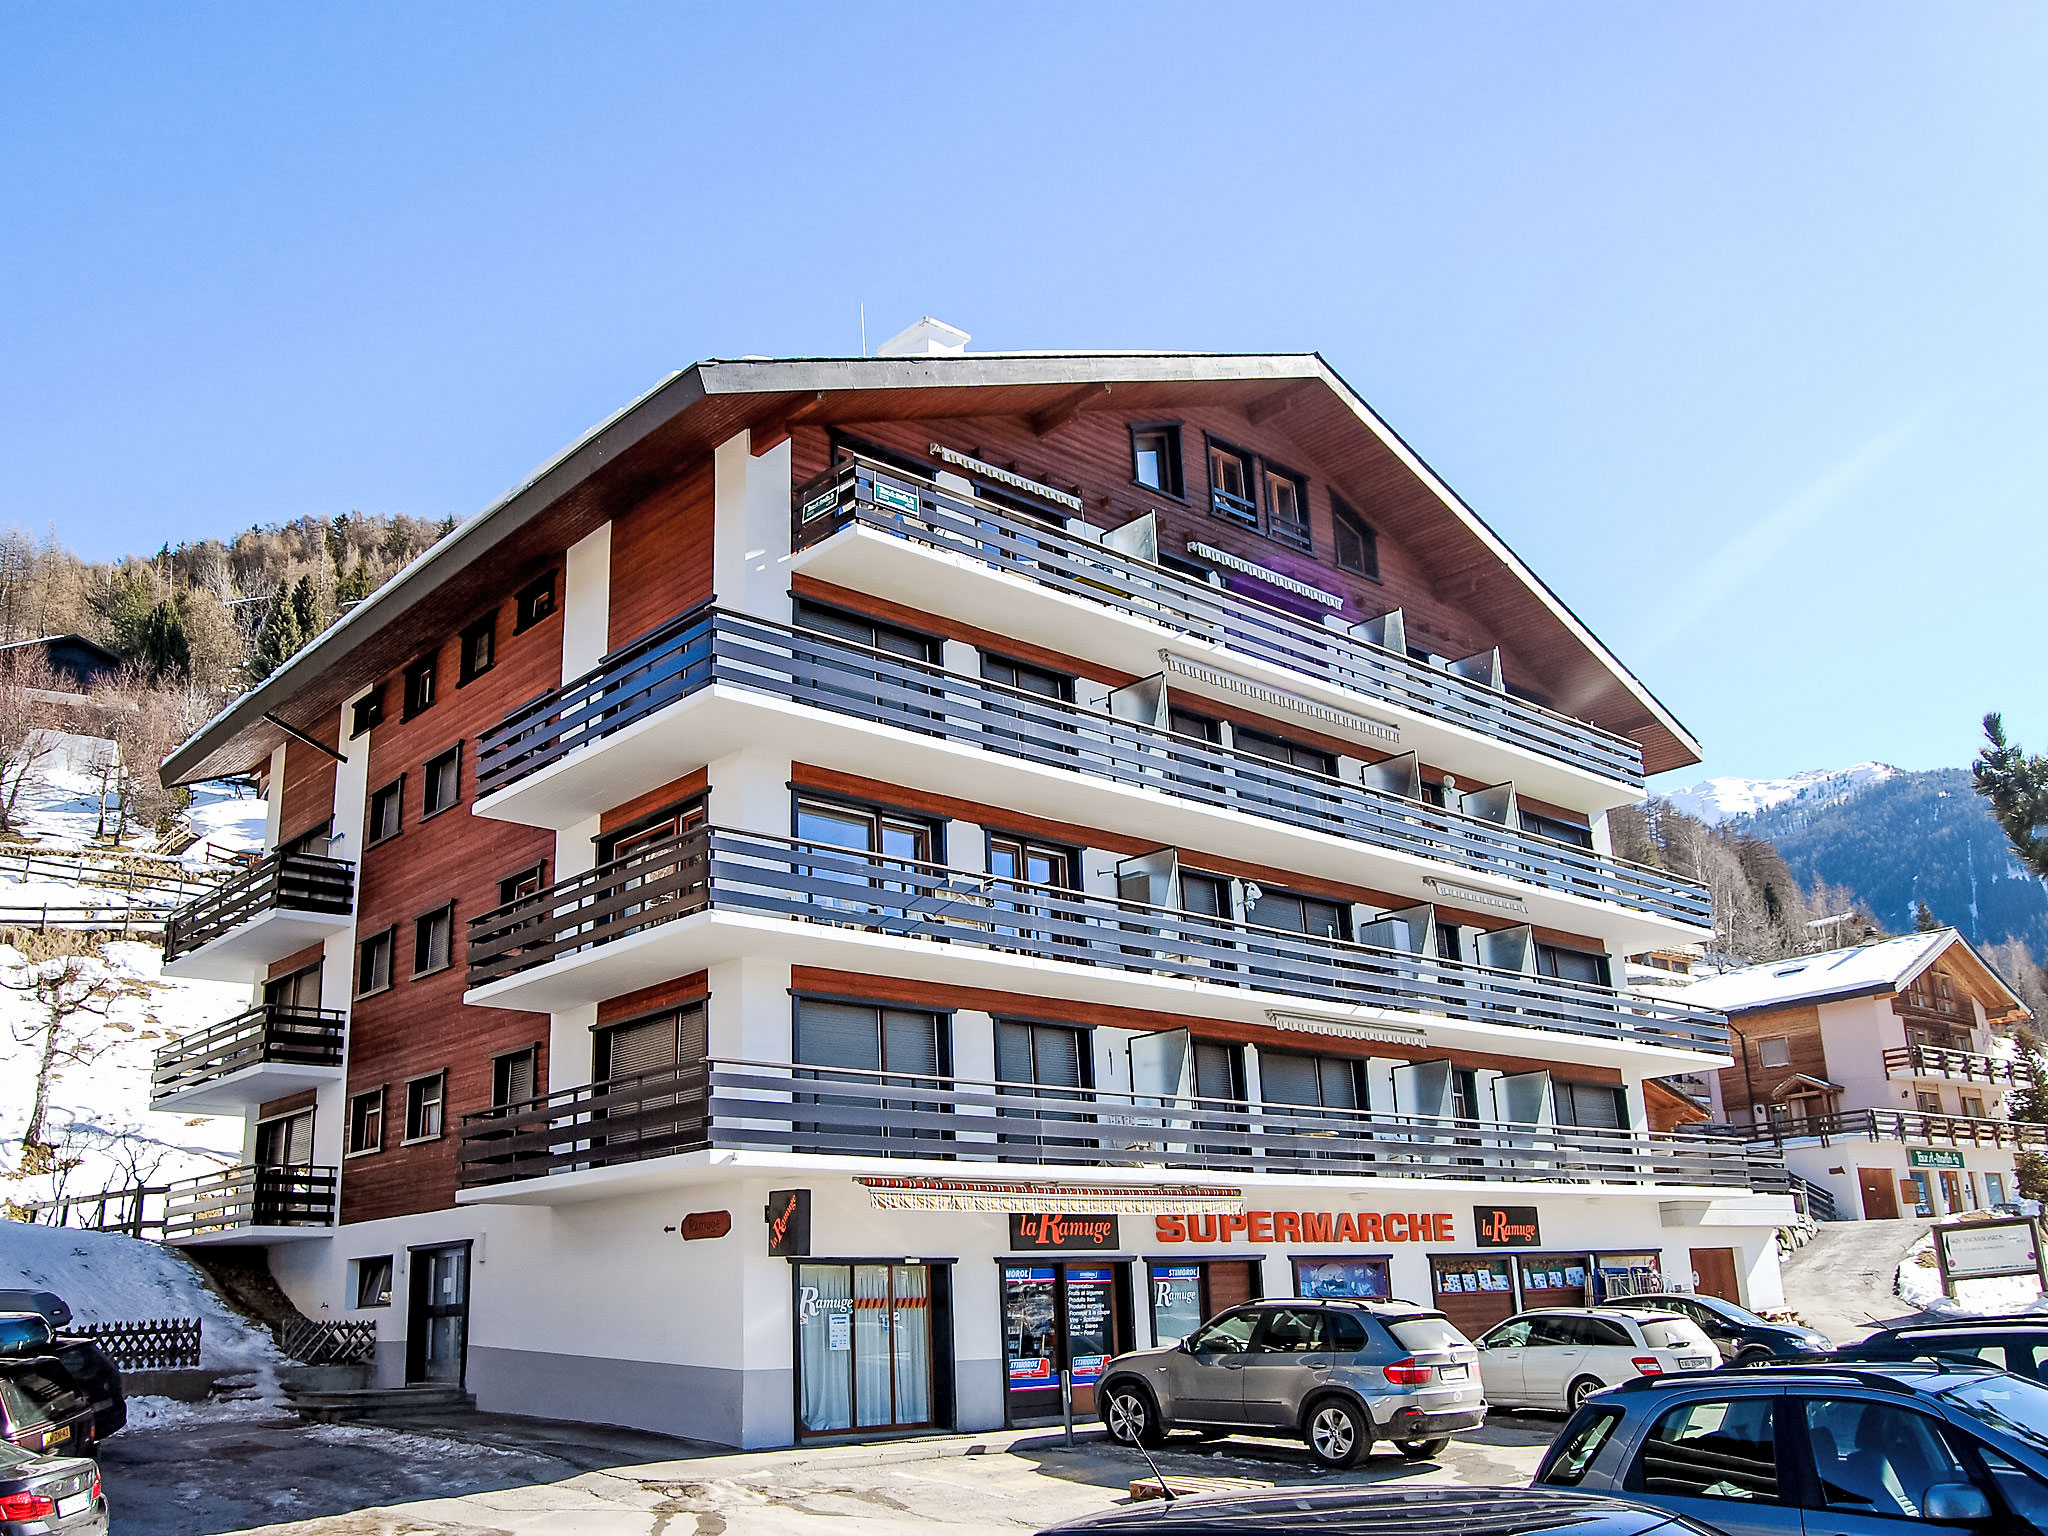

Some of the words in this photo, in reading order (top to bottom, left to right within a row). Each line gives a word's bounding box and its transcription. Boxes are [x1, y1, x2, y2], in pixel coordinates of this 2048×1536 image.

[772, 1194, 797, 1243] Ramuge
[1020, 1214, 1037, 1236] la
[1035, 1214, 1112, 1245] Ramuge
[1155, 1210, 1456, 1243] SUPERMARCHE
[1482, 1218, 1492, 1236] la
[1491, 1211, 1536, 1242] Ramuge
[800, 1286, 853, 1317] Ramuge
[1155, 1281, 1196, 1307] Ramuge
